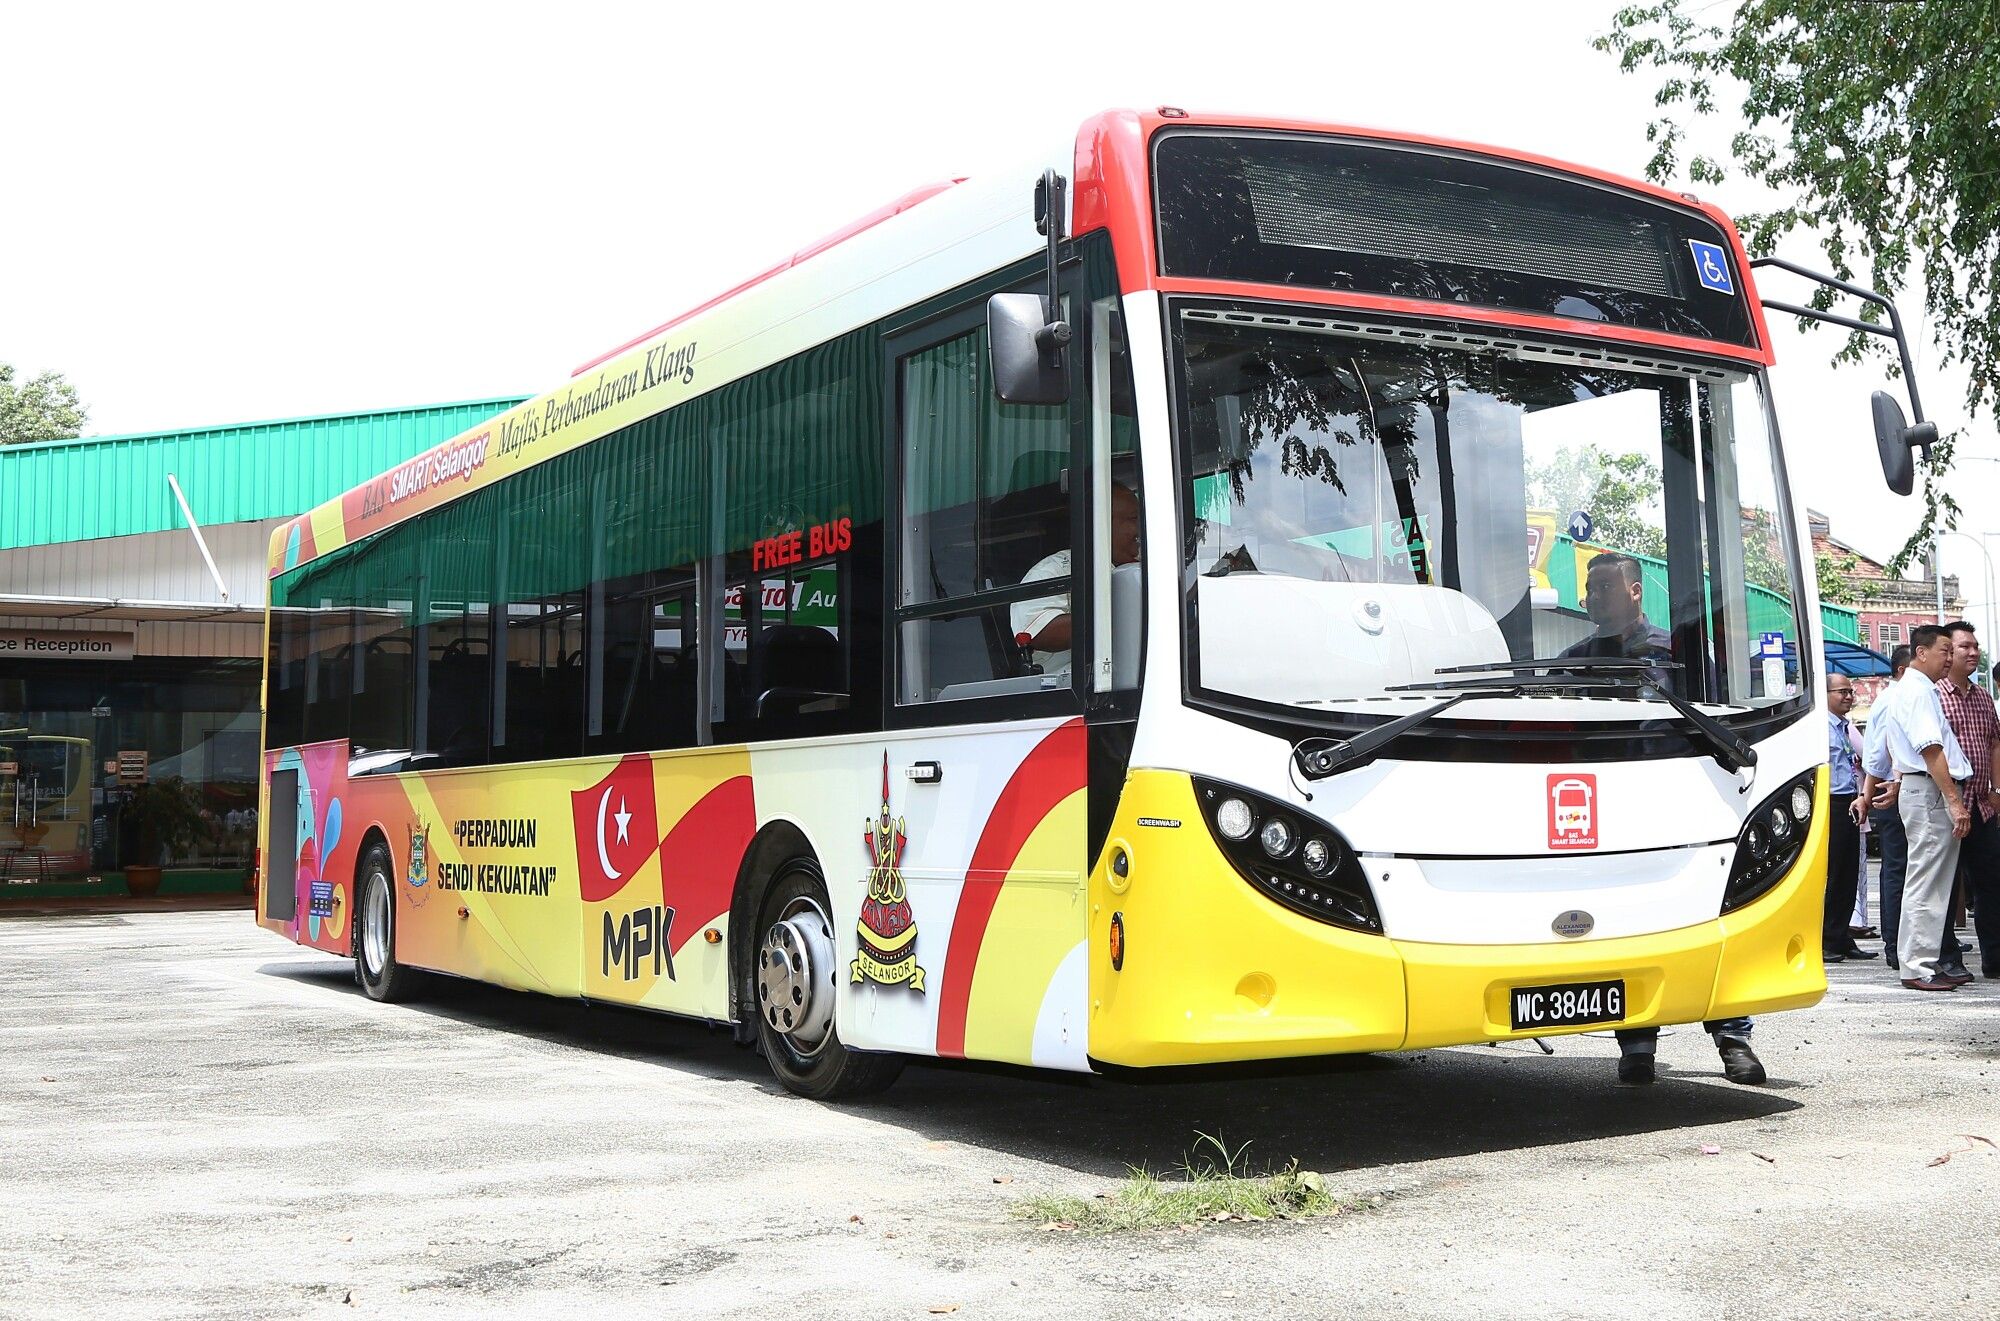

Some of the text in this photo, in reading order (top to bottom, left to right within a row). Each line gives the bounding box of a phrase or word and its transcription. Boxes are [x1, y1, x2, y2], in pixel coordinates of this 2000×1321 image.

[361, 341, 697, 519] BAS SMART Selangor Majlis Perbandaran Klang
[753, 517, 852, 572] FREE BUS
[24, 637, 112, 654] Reception
[1138, 818, 1180, 827] SCREENWASH
[437, 863, 473, 891] SENDI
[602, 906, 676, 982] MPK
[862, 957, 911, 980] SELANGOR
[1517, 987, 1620, 1022] WC 3844 G
